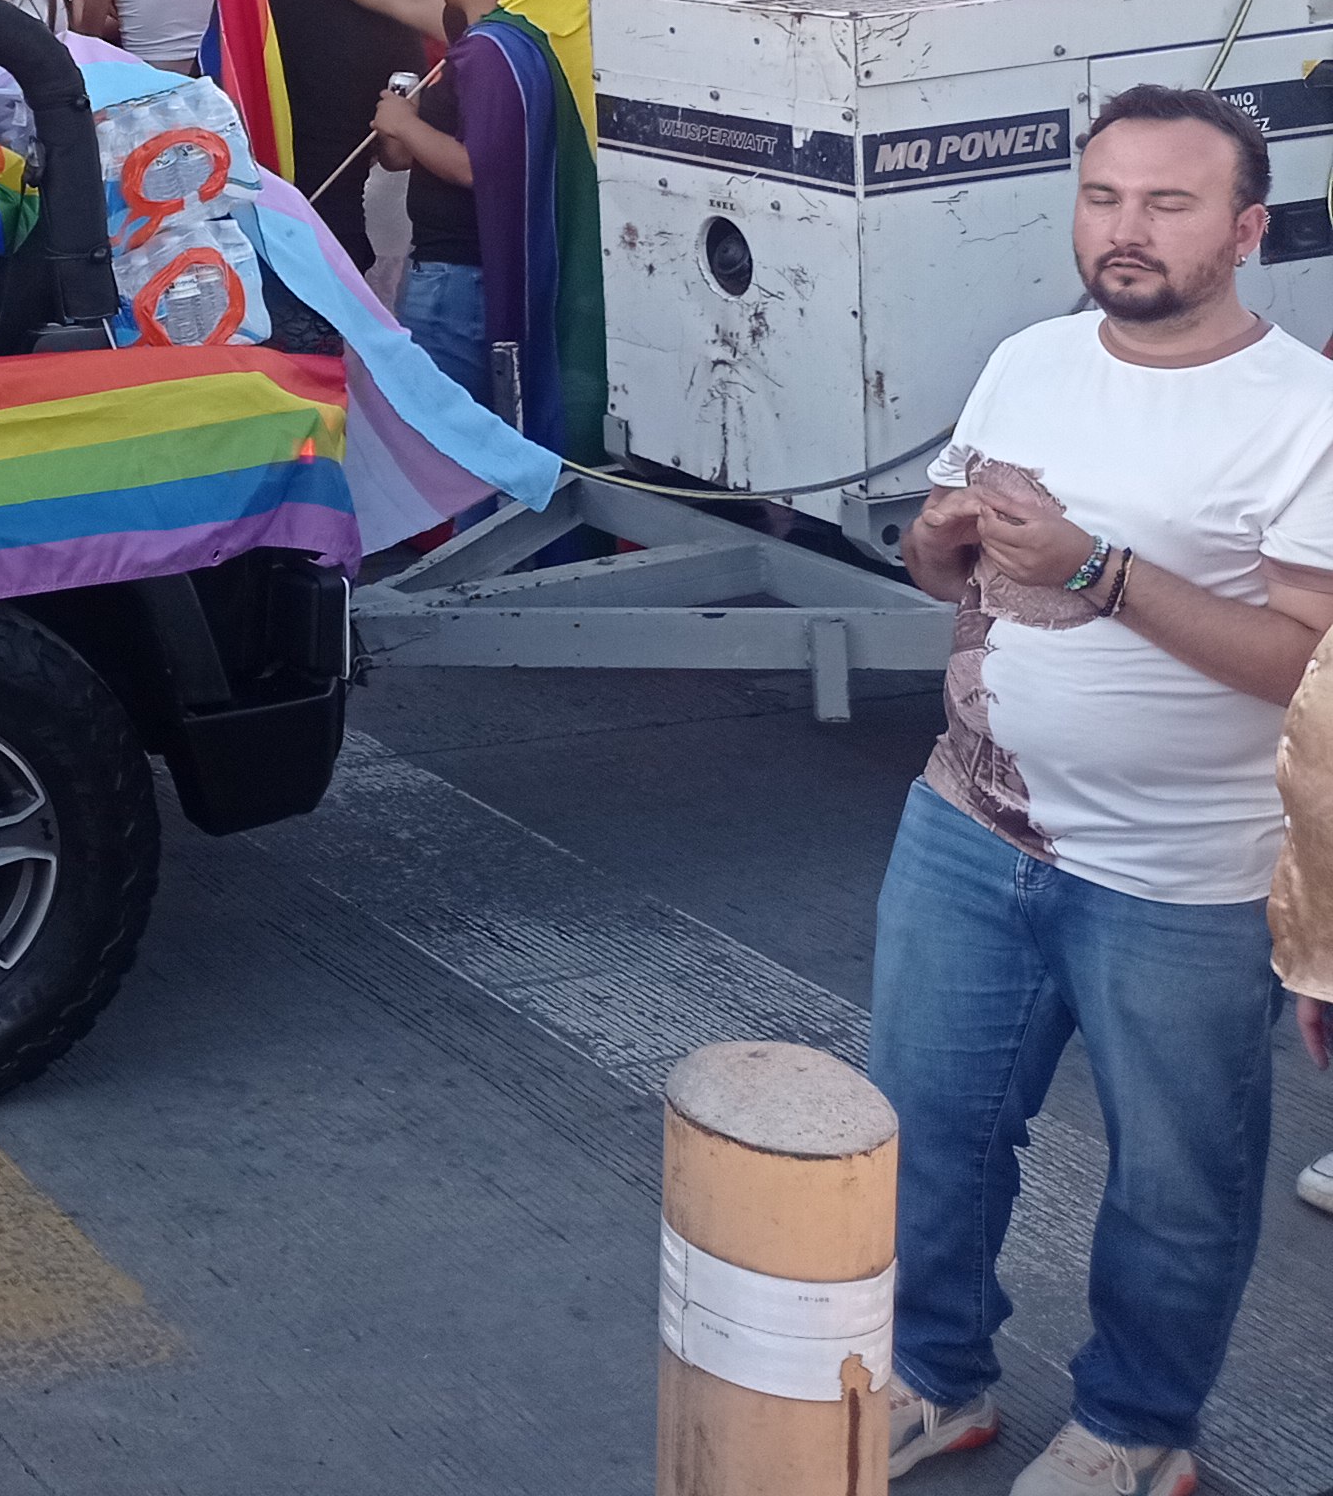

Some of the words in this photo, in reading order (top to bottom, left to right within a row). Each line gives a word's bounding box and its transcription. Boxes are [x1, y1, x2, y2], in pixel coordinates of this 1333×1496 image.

[658, 118, 778, 155] WHISPERWATT
[874, 138, 932, 173] MQ
[936, 122, 1060, 165] POWER
